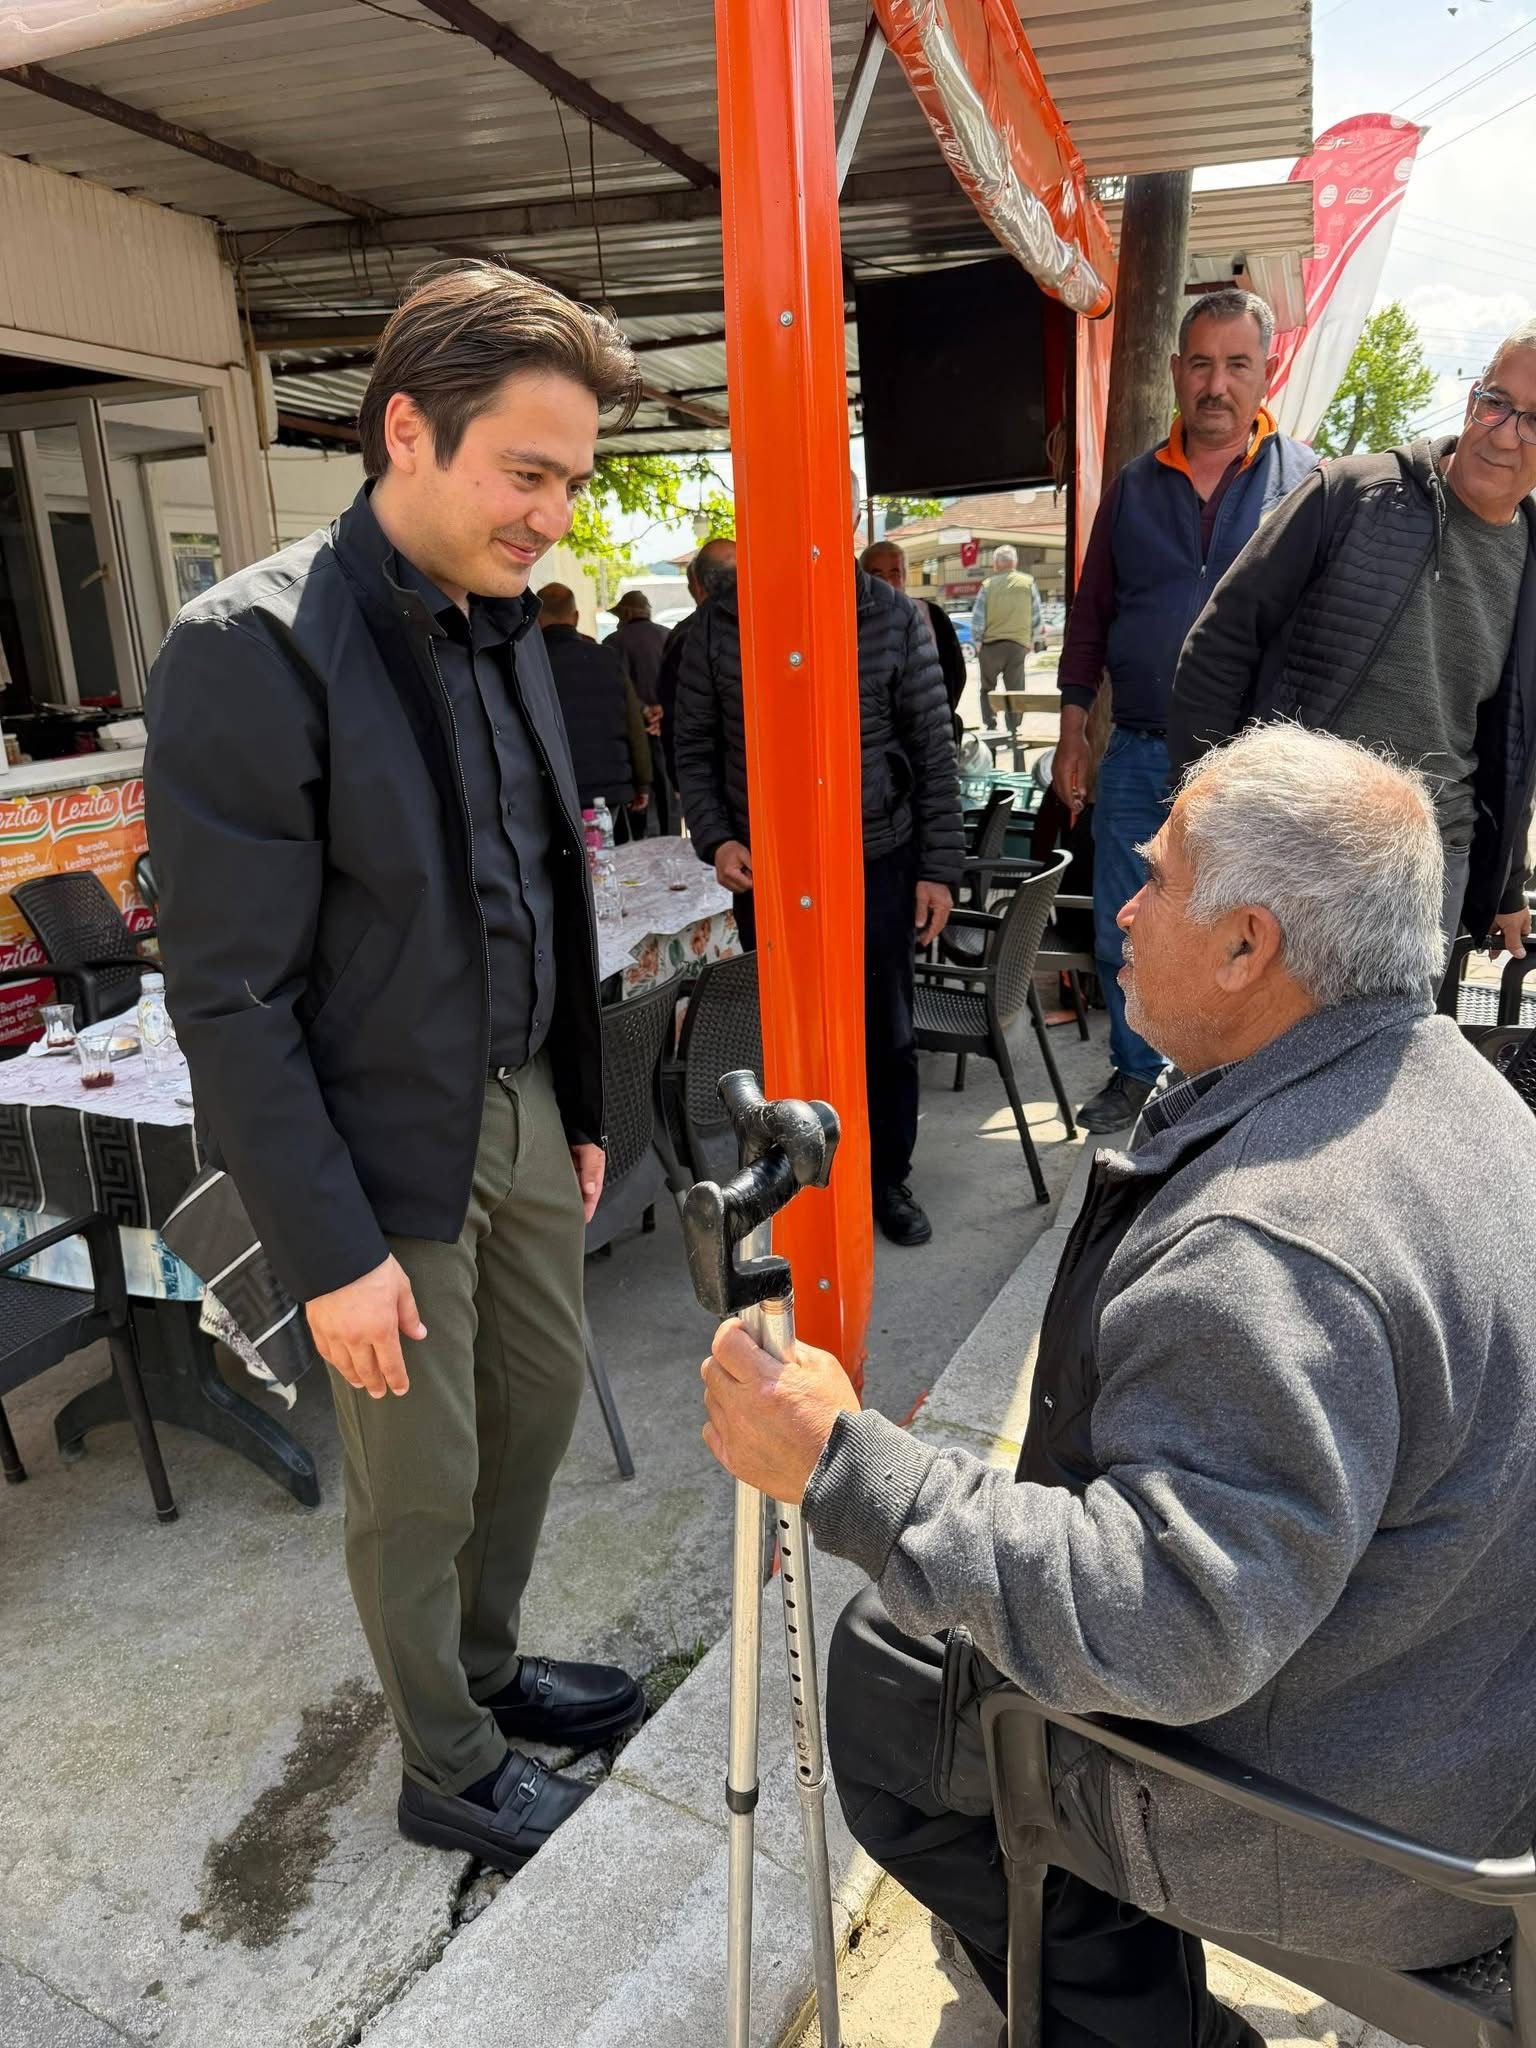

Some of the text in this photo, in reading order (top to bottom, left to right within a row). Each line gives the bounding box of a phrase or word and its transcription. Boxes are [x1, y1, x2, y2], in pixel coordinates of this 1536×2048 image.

[0, 803, 42, 828] ezita
[58, 794, 114, 825] Lezita
[0, 993, 36, 1013] Burada
